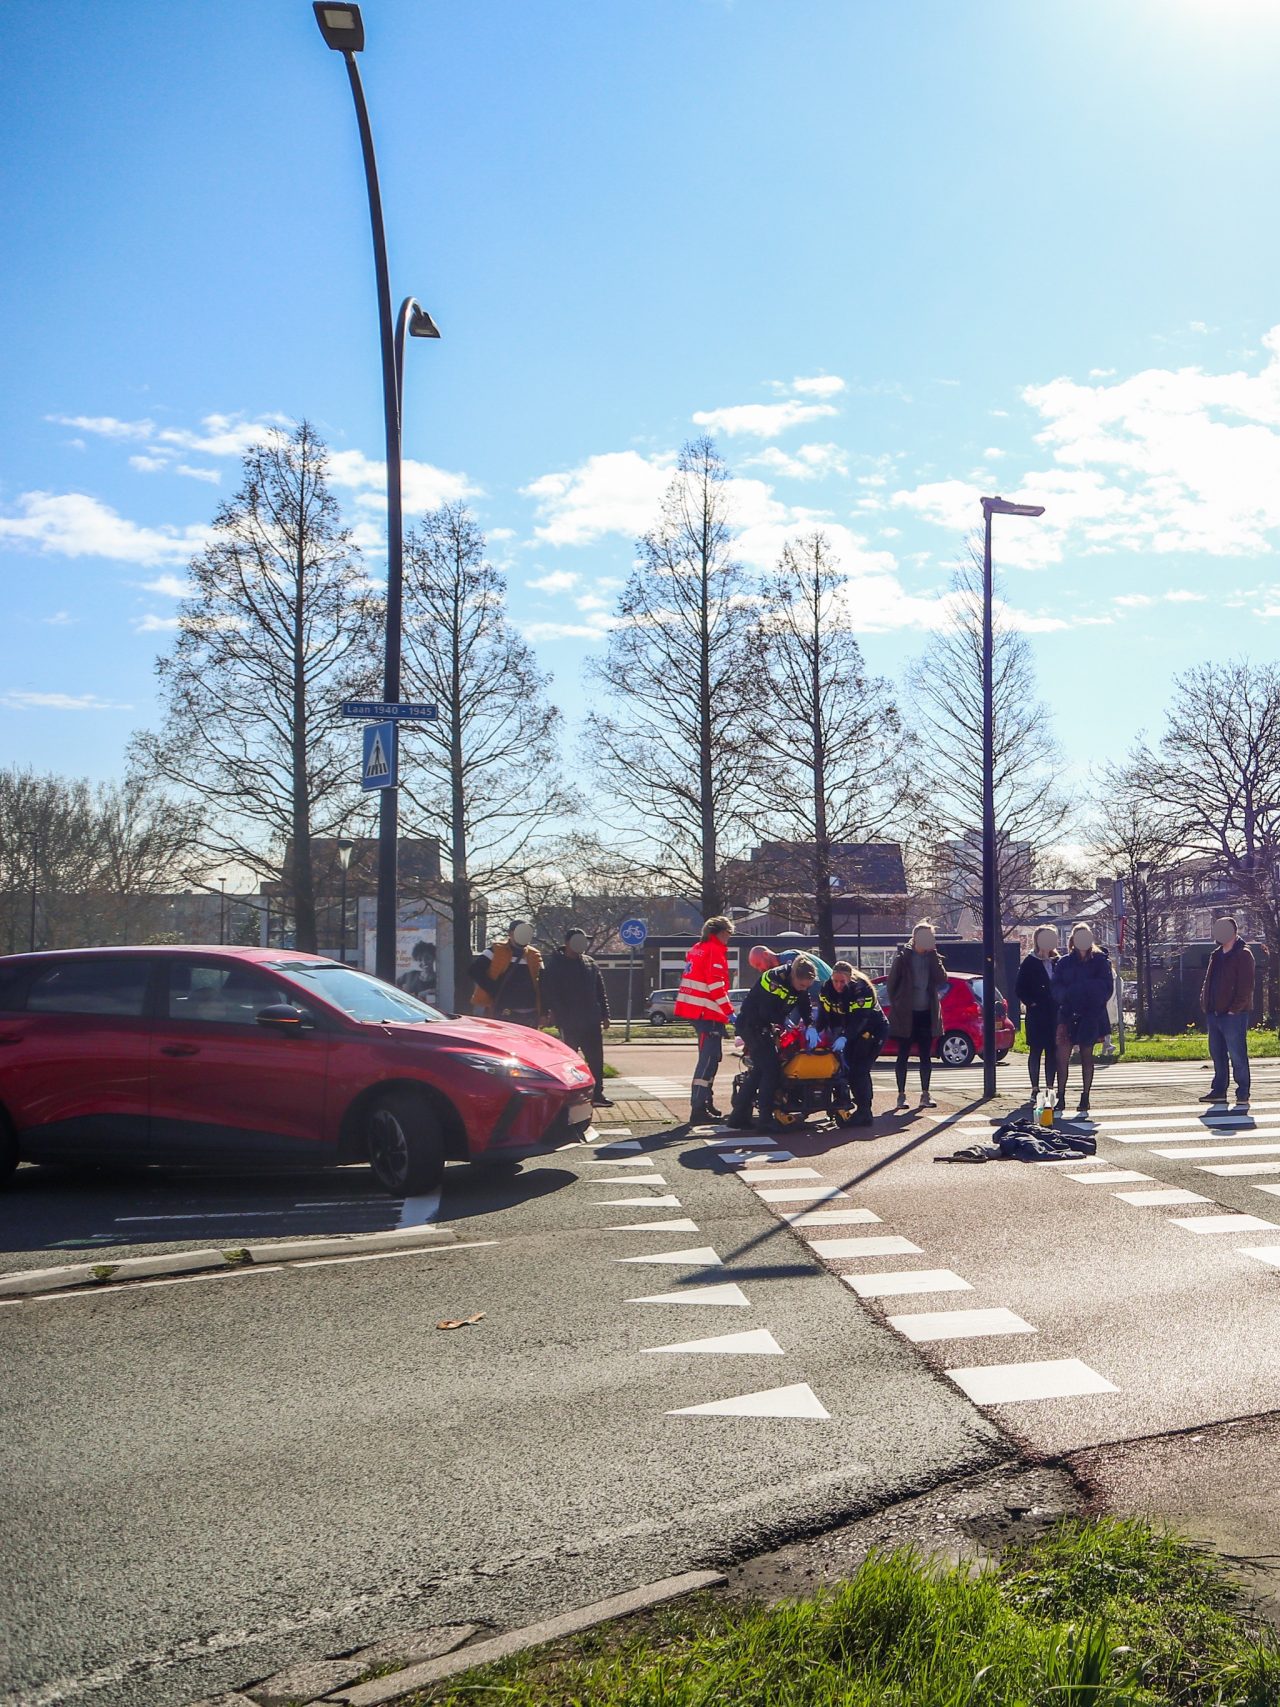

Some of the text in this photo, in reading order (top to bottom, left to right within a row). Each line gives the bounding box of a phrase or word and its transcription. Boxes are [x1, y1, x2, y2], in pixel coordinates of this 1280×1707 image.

[347, 705, 370, 714] Laan
[374, 706, 398, 715] 1940
[409, 707, 433, 716] 1945
